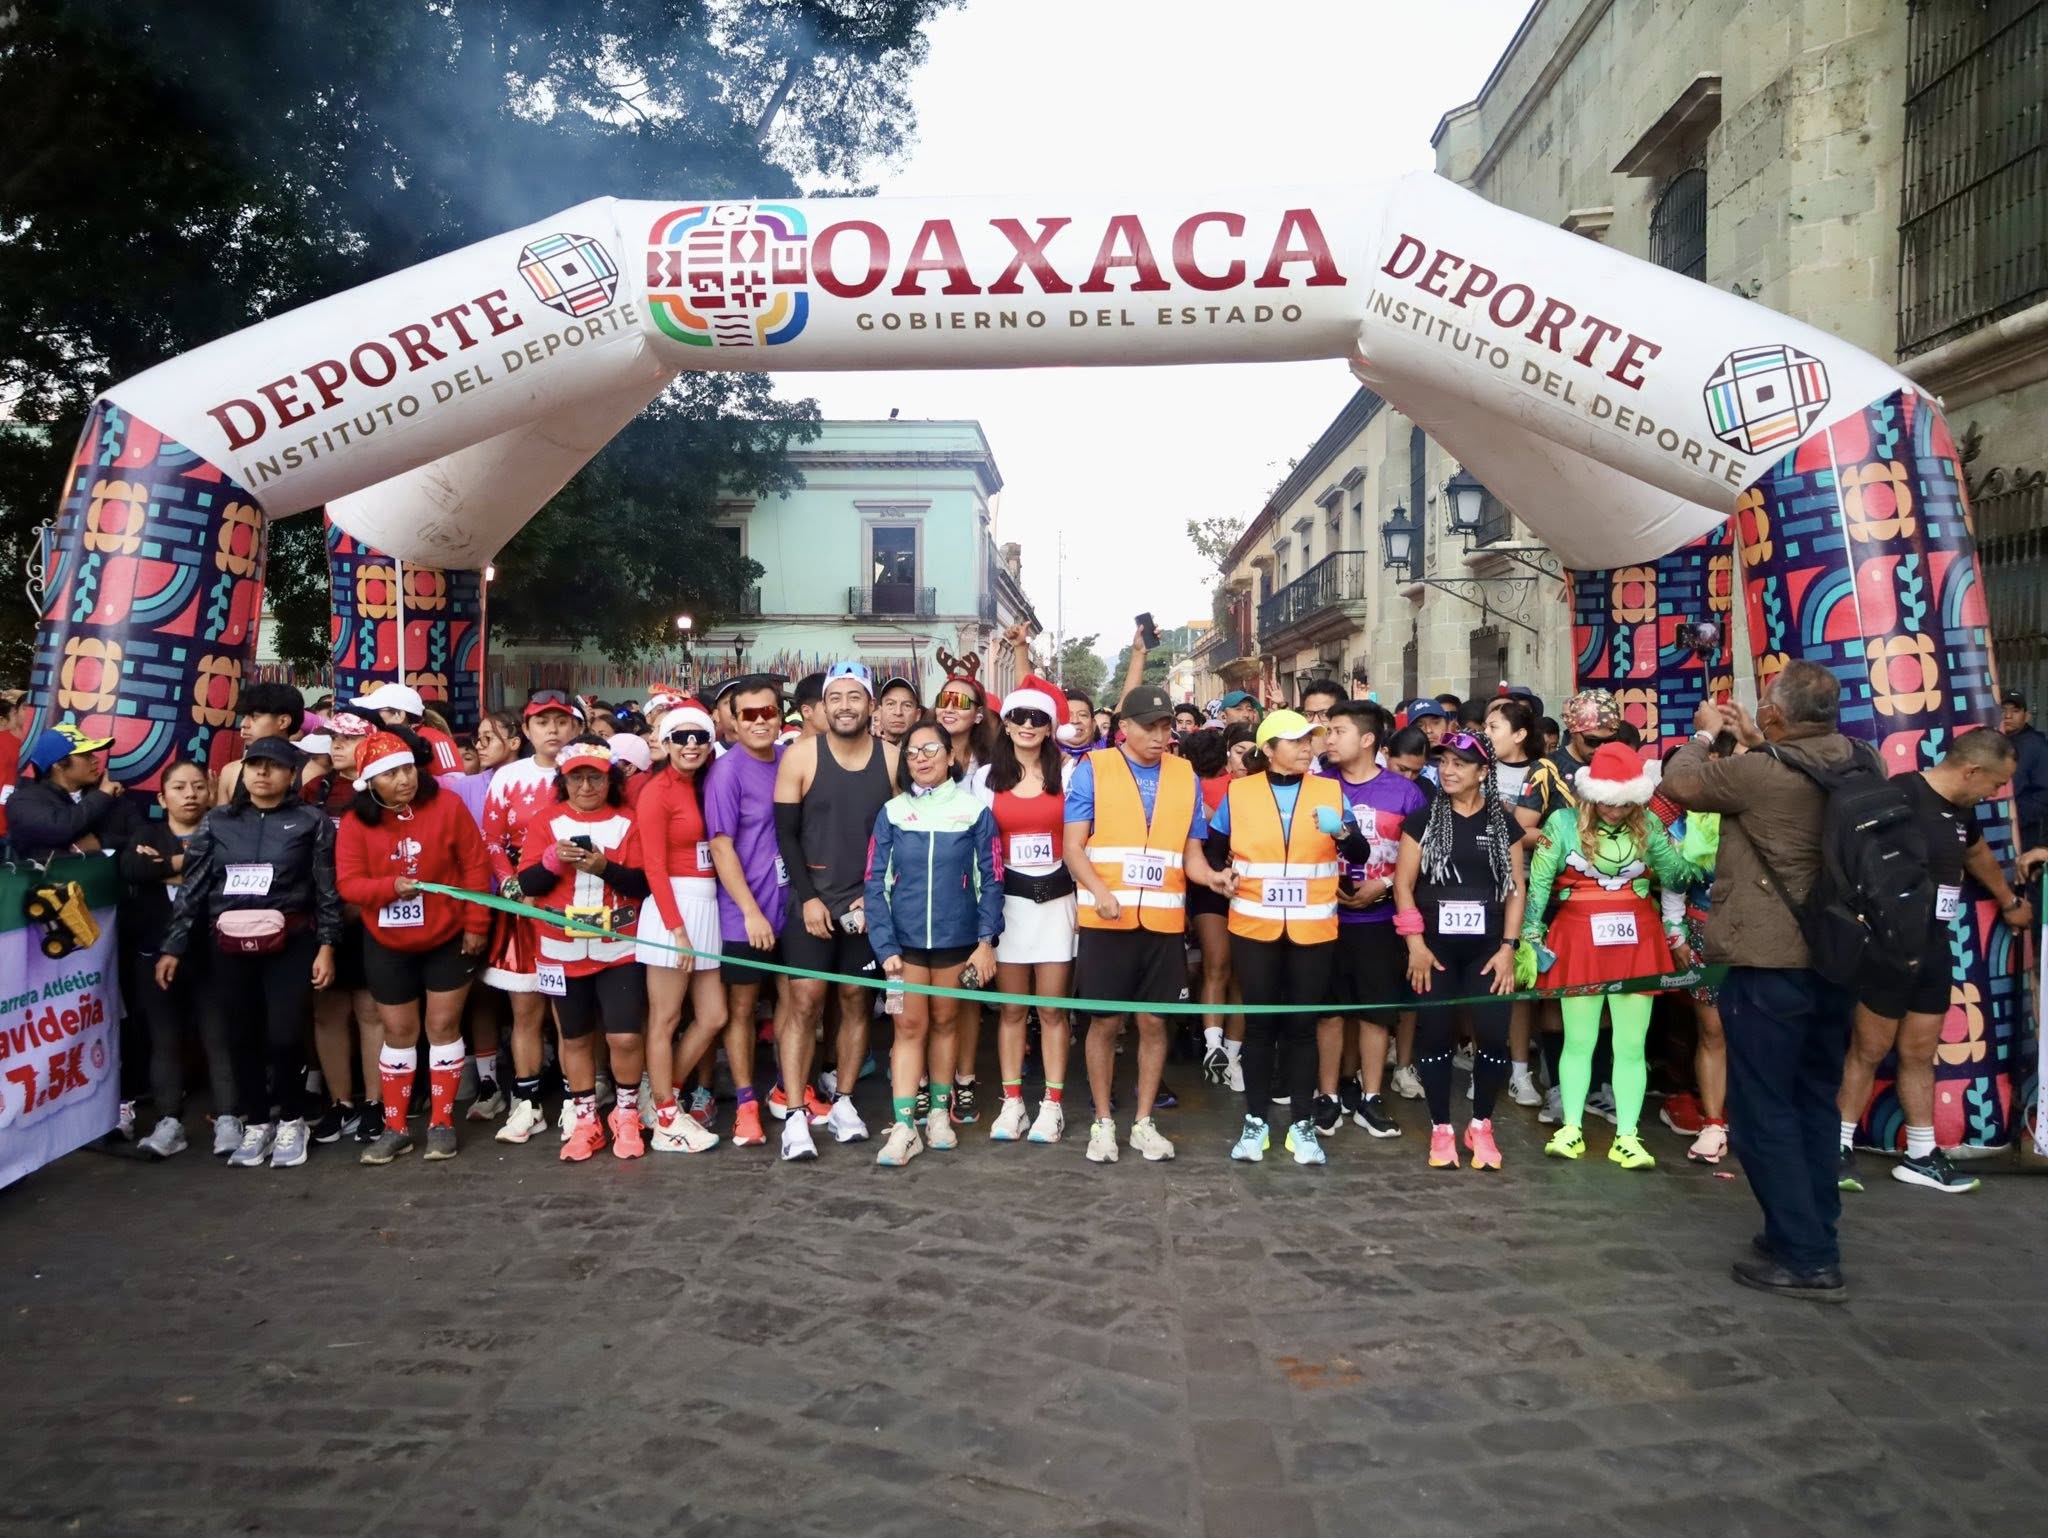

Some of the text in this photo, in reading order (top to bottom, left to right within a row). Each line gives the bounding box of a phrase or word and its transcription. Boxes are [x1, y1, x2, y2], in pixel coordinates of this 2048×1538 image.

[811, 209, 1347, 299] OAXACA
[856, 304, 1303, 330] GOBIERNO DEL ESTADO
[1380, 233, 1663, 391] DEPORTE
[206, 288, 523, 452] DEPORTE
[243, 302, 638, 488] INSTITUTO DEL DEPORTE
[1365, 288, 1747, 488] INSTITUTO DEL DEPORTE
[1359, 818, 1374, 832] 14
[700, 849, 712, 864] 10
[1015, 844, 1050, 859] 1094
[231, 874, 269, 888] 0478
[1127, 863, 1163, 882] 3100
[1267, 887, 1303, 902] 3111
[386, 904, 421, 920] 1583
[1444, 912, 1481, 927] 3127
[1597, 923, 1634, 938] 2986
[0, 970, 102, 1014] arrera Atlética
[0, 993, 104, 1061] avideña
[5, 1041, 90, 1114] 7.5K
